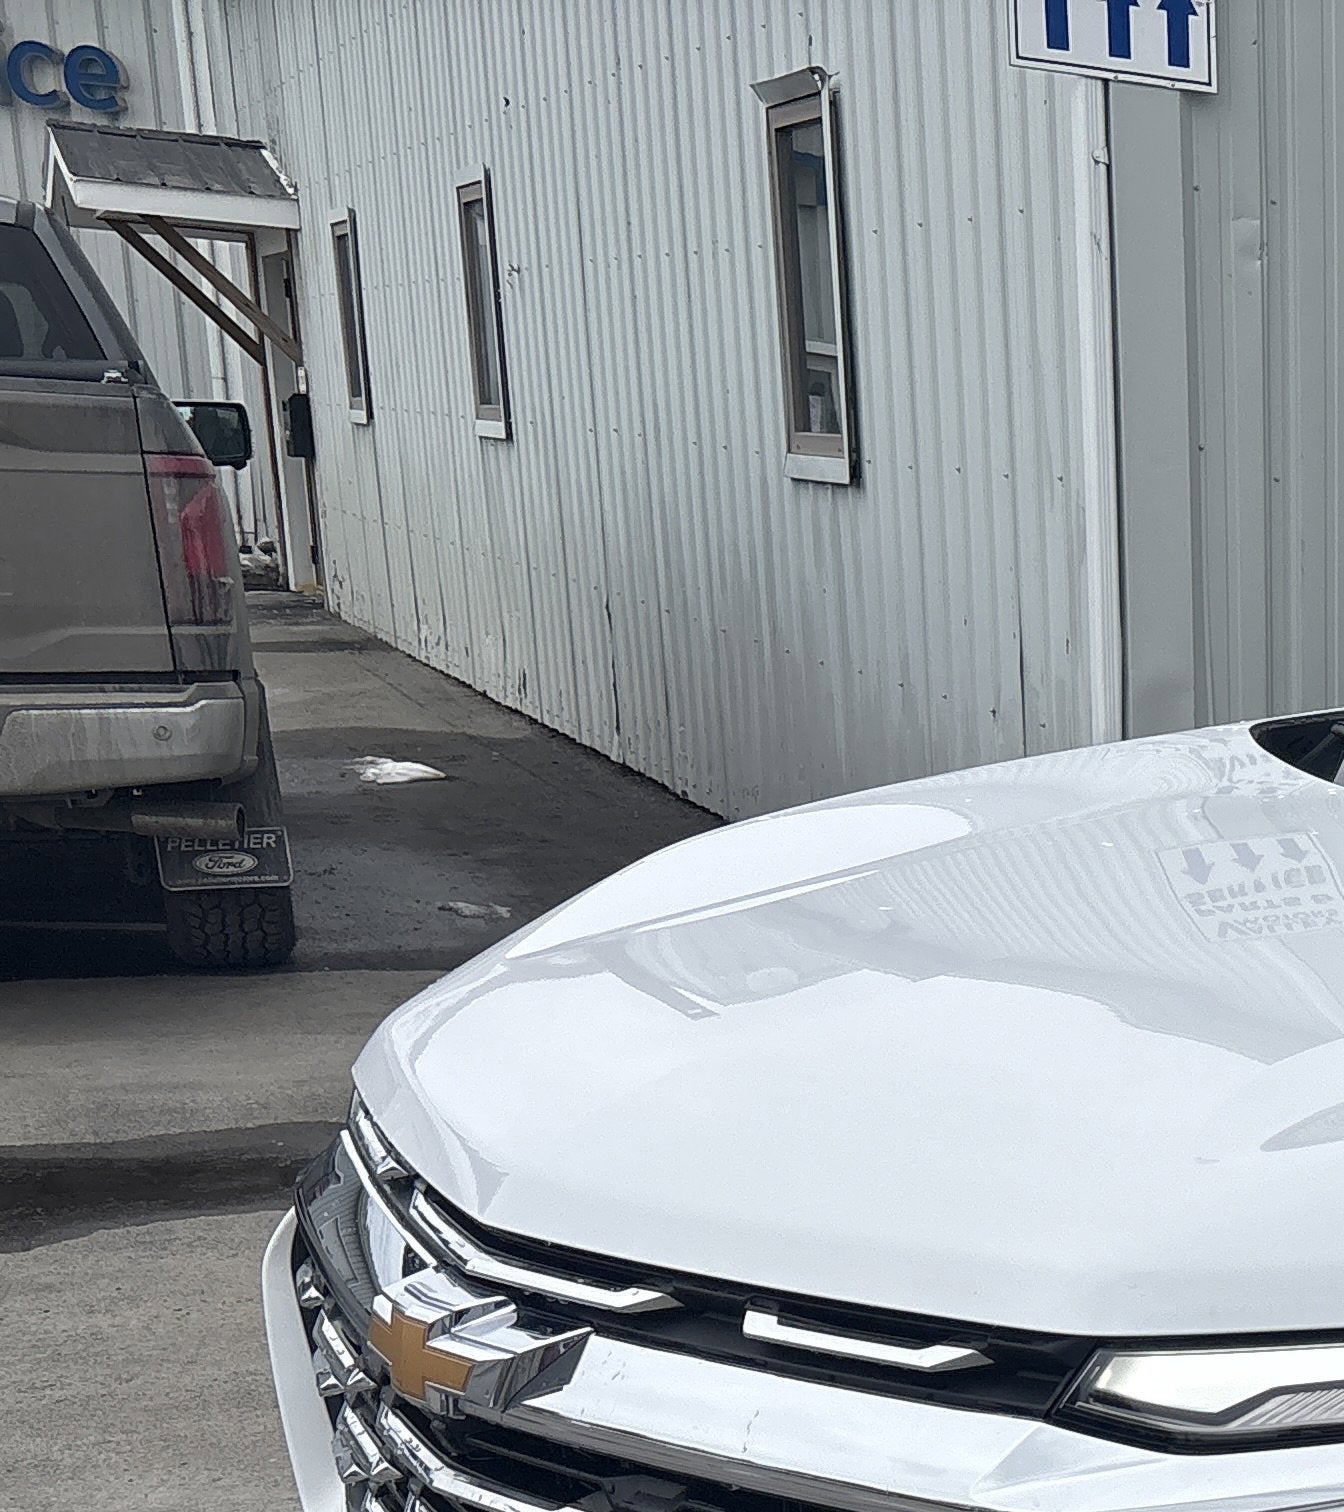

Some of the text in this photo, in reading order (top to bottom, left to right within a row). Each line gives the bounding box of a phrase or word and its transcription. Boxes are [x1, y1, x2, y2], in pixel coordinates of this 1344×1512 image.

[0, 40, 128, 113] ce
[167, 833, 277, 851] PELLEIER
[205, 855, 246, 870] Ford
